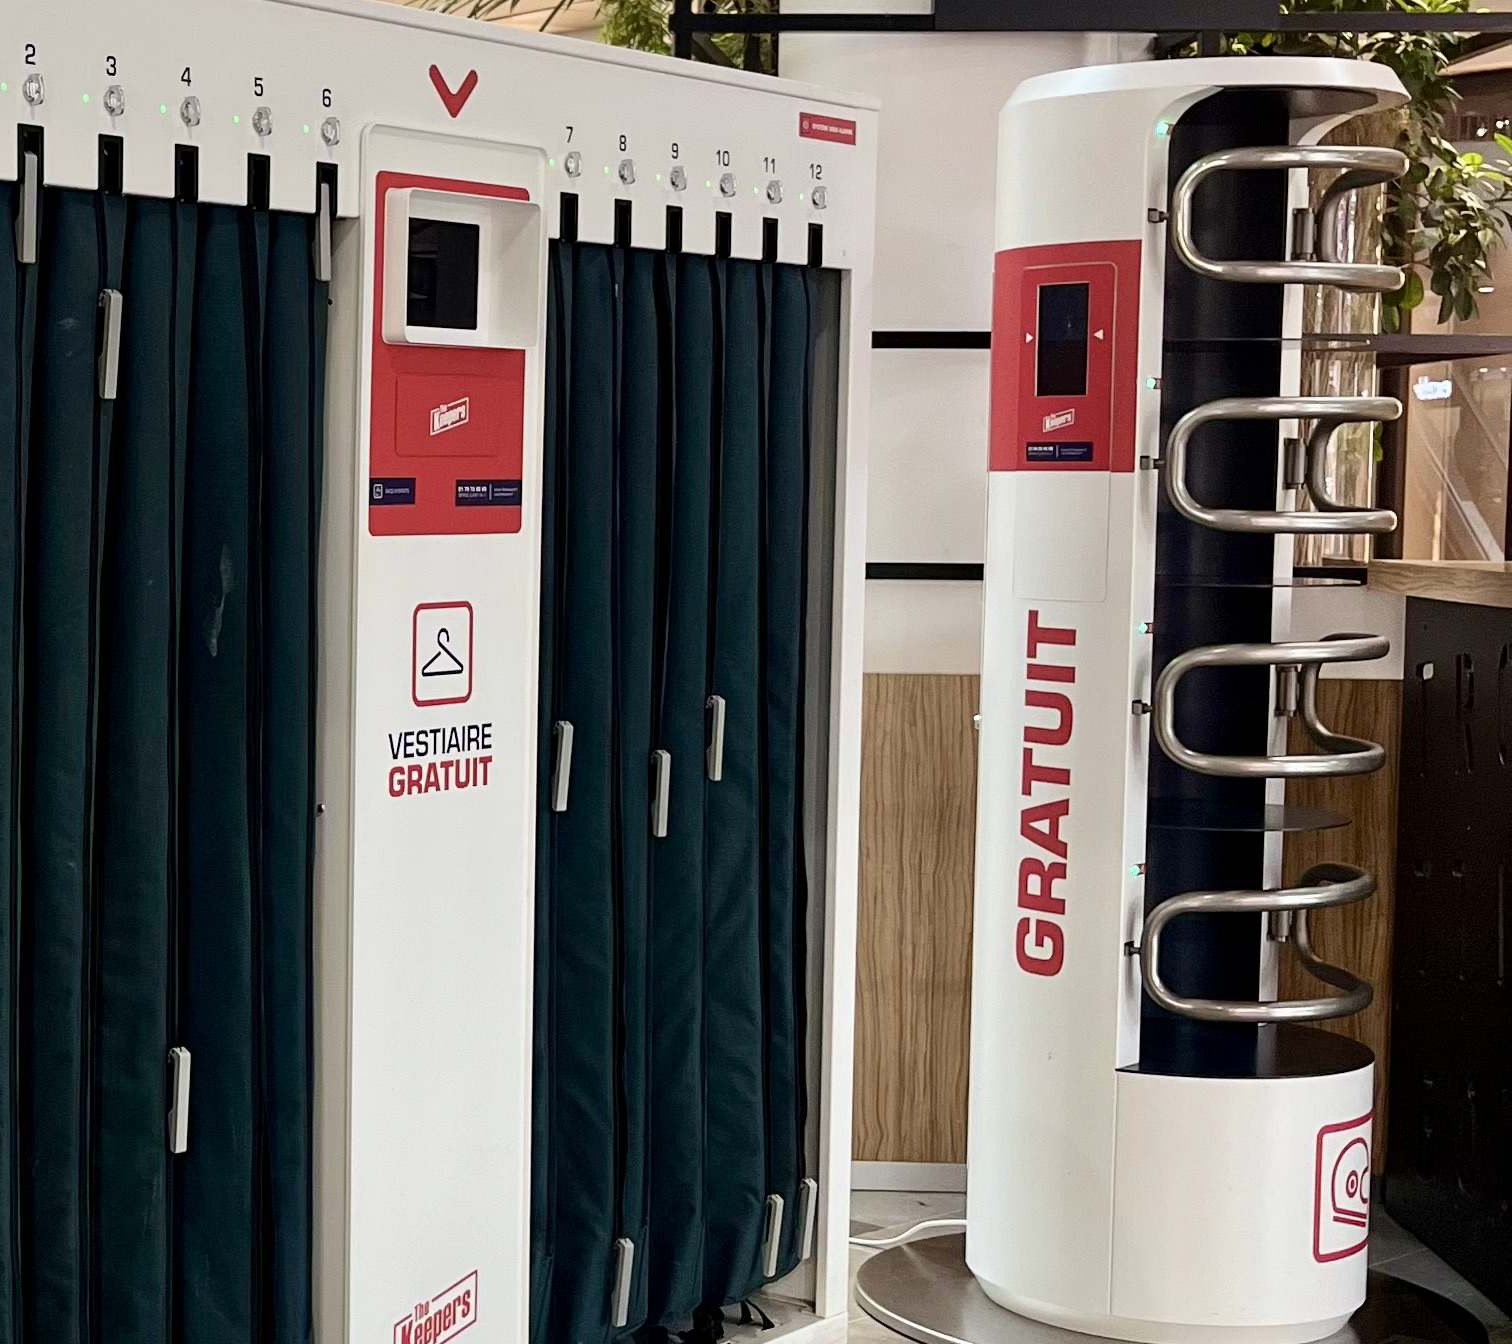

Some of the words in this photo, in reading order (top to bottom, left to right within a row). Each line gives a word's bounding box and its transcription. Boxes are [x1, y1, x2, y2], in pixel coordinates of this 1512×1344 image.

[24, 44, 36, 65] 2
[106, 56, 117, 77] 3
[181, 67, 191, 87] 4
[254, 77, 264, 97] 5
[322, 88, 332, 107] 6
[566, 127, 574, 144] 7
[619, 135, 627, 152] 8
[671, 143, 679, 159] 9
[716, 150, 730, 167] 10
[763, 157, 777, 174] 11
[809, 164, 823, 181] 12
[388, 723, 492, 760] VESTIAIRE
[388, 755, 493, 798] GRATUIT
[1016, 609, 1077, 977] GRATUIT
[414, 1301, 429, 1322] The
